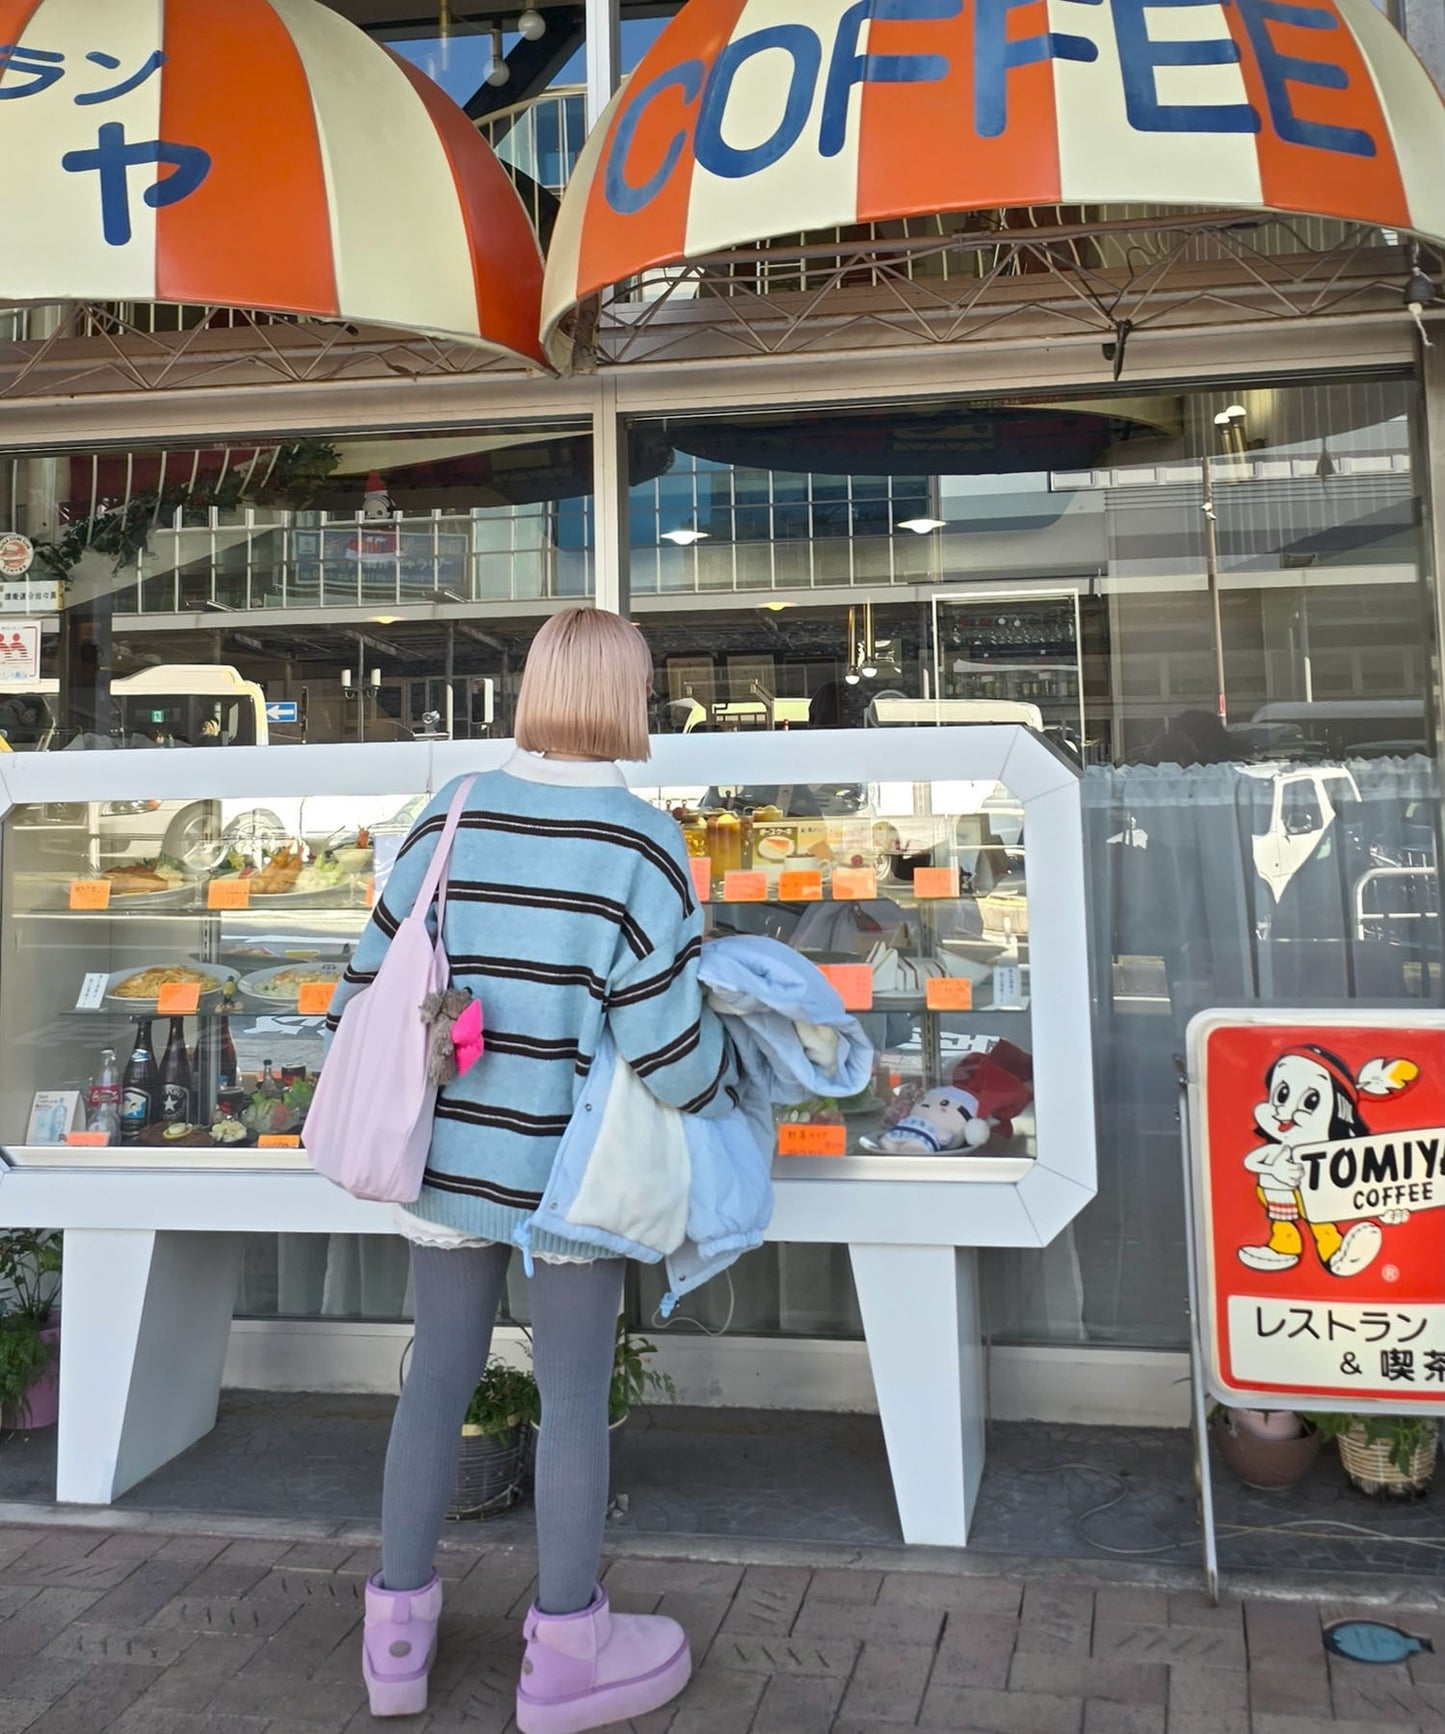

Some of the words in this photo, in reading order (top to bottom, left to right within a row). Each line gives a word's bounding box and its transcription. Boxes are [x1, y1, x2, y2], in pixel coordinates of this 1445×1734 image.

[603, 0, 1378, 215] COFFEE
[1300, 1138, 1445, 1191] TOMIY
[1353, 1181, 1433, 1210] COFFEE
[1256, 1305, 1428, 1343] レストラン
[1339, 1351, 1363, 1375] &
[1379, 1347, 1445, 1383] 喫茶
